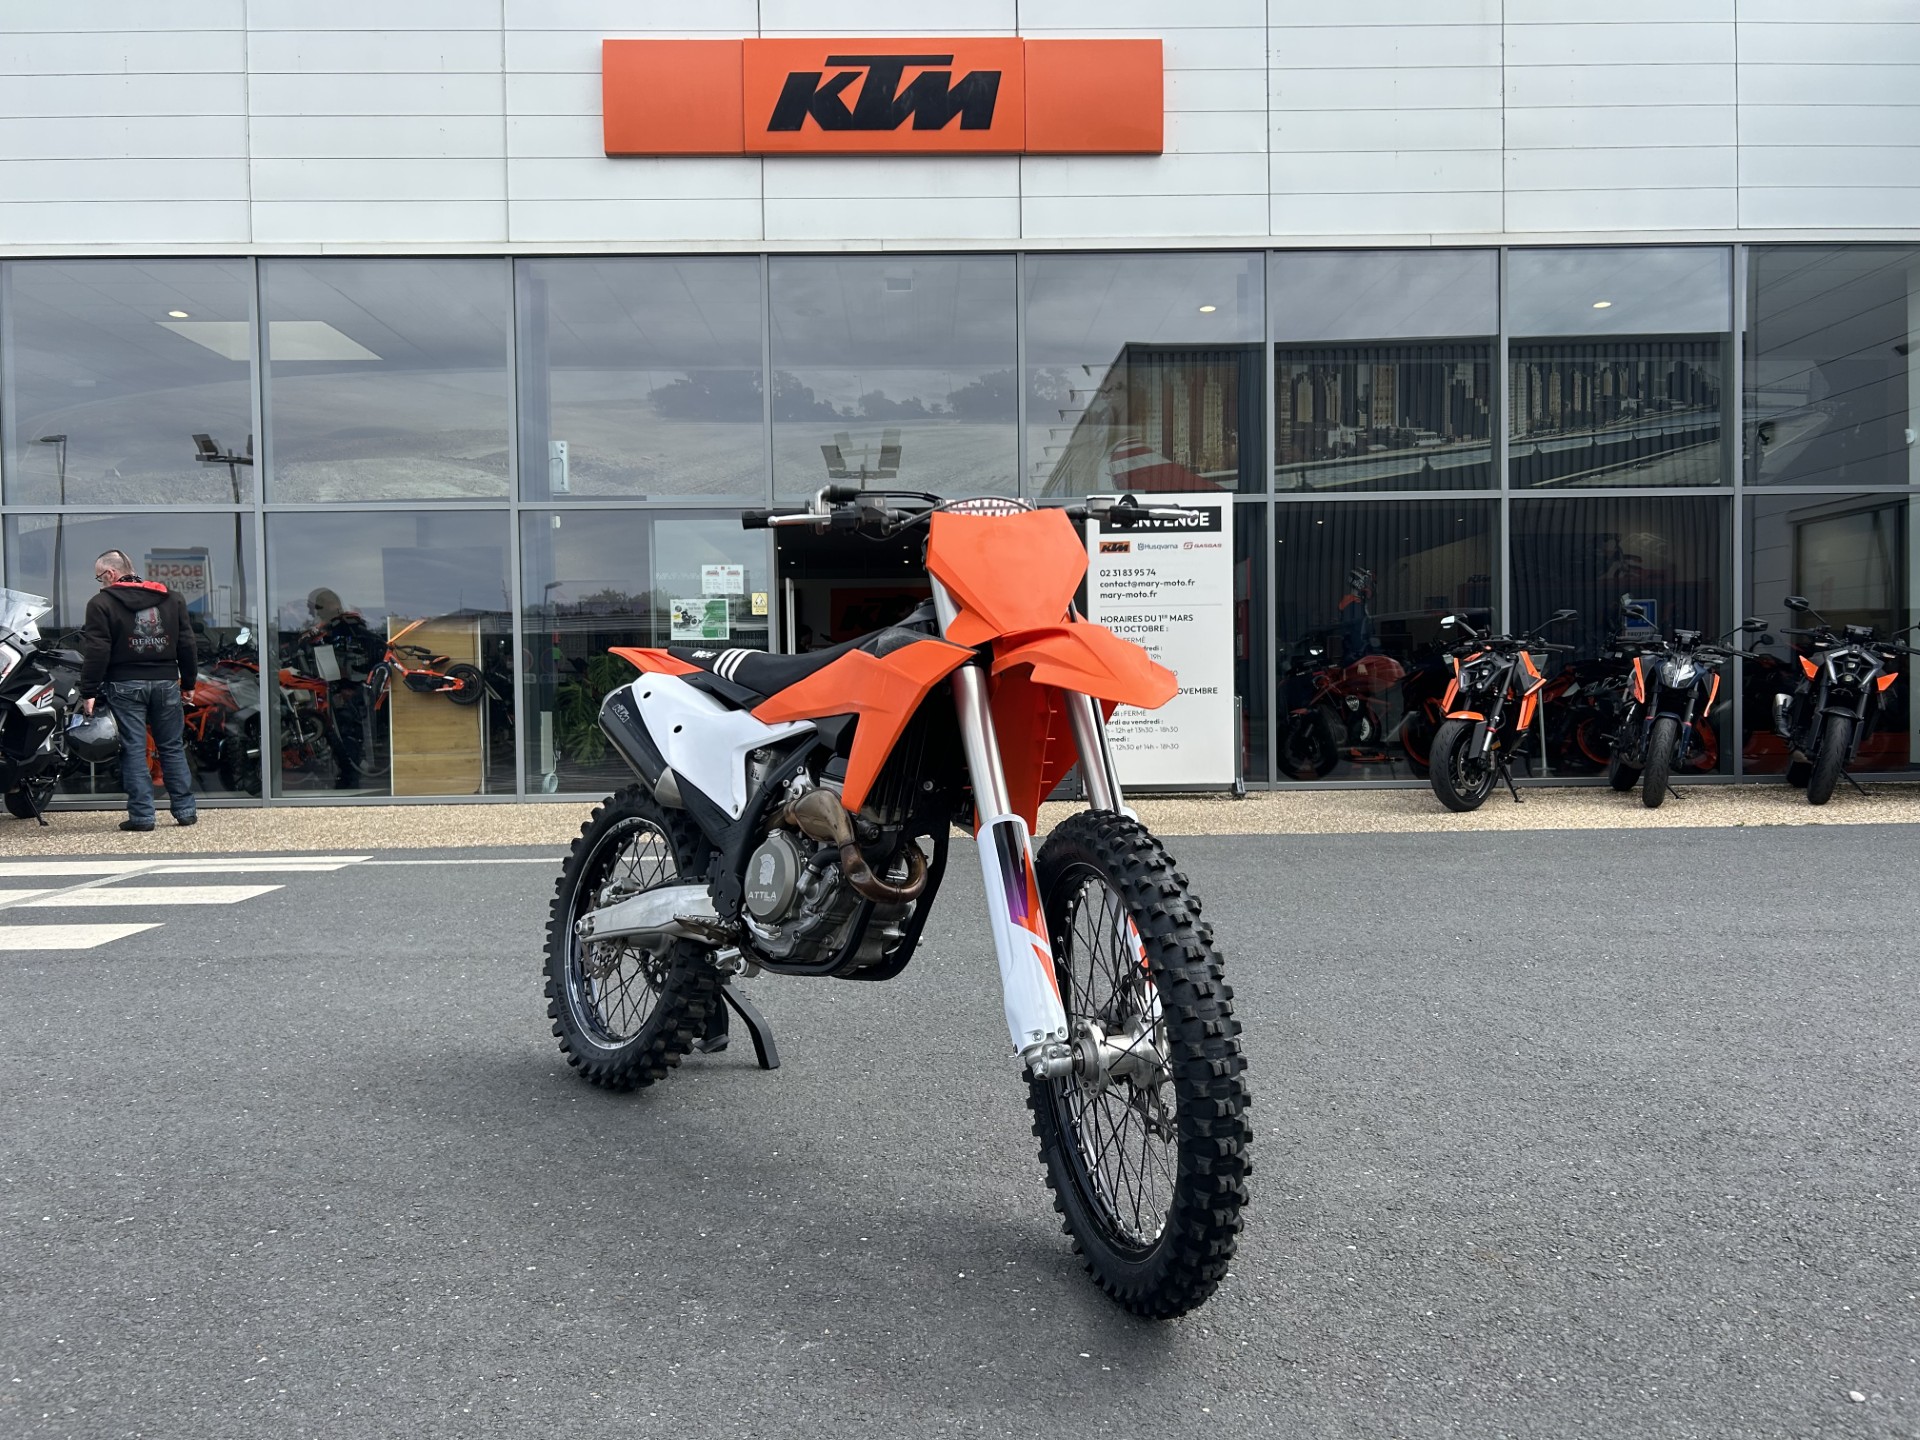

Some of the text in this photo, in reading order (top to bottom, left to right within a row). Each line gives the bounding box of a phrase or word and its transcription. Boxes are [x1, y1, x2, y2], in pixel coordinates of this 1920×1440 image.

[767, 54, 1001, 131] KTM
[1101, 542, 1129, 552] KTM
[1145, 542, 1178, 551] Husqvarna
[1099, 569, 1111, 577] 02
[1113, 569, 1121, 577] 31
[1122, 569, 1133, 577] 83
[1146, 568, 1156, 576] 74
[1099, 579, 1195, 589] contact@mary-moto.fr
[1100, 590, 1157, 600] mary-moto.fr
[1100, 615, 1143, 623] HORAIRES
[1169, 614, 1194, 622] MARS
[1113, 625, 1122, 633] 31
[1123, 625, 1164, 633] OCTOBRE
[132, 637, 167, 645] BERING
[1177, 687, 1218, 695] OVEMBRE
[612, 704, 630, 723] KTM
[1123, 709, 1147, 717] FERMÉ
[1116, 743, 1135, 751] 12h30
[747, 891, 777, 899] ATTILA
